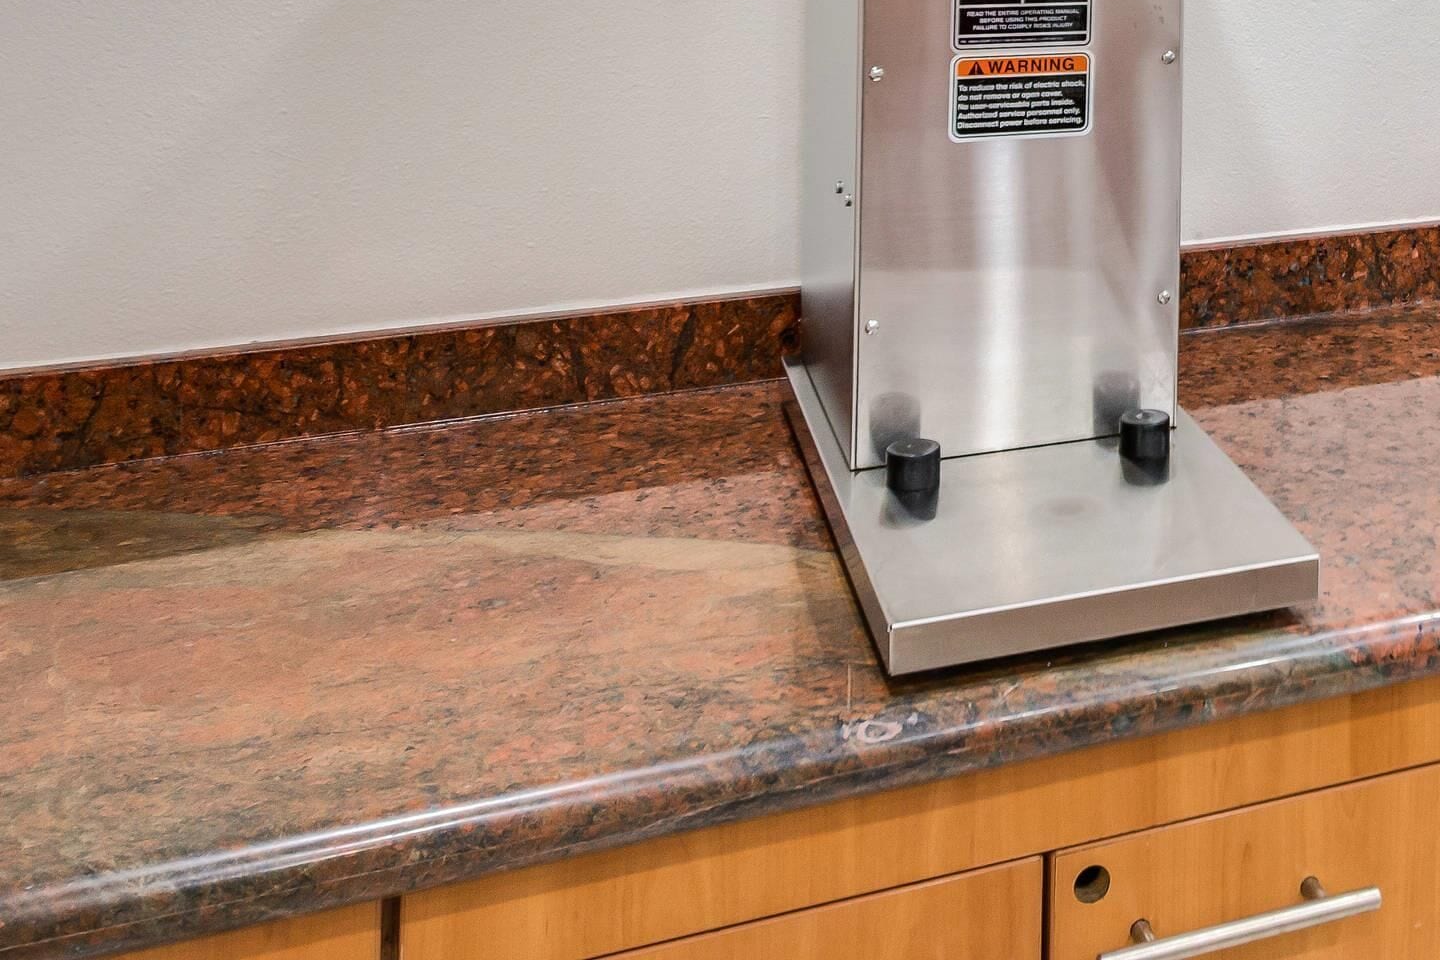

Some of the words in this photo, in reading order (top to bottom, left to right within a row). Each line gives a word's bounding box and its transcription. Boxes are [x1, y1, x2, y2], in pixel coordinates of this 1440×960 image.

[988, 58, 1075, 73] WARNING
[1033, 81, 1060, 89] electric
[1021, 92, 1040, 100] open
[1031, 100, 1050, 108] parts
[958, 111, 998, 119] Authorized
[998, 110, 1026, 118] service
[1026, 109, 1063, 117] personnel
[957, 121, 999, 129] Disconnect
[999, 120, 1023, 128] power
[1023, 118, 1048, 126] before
